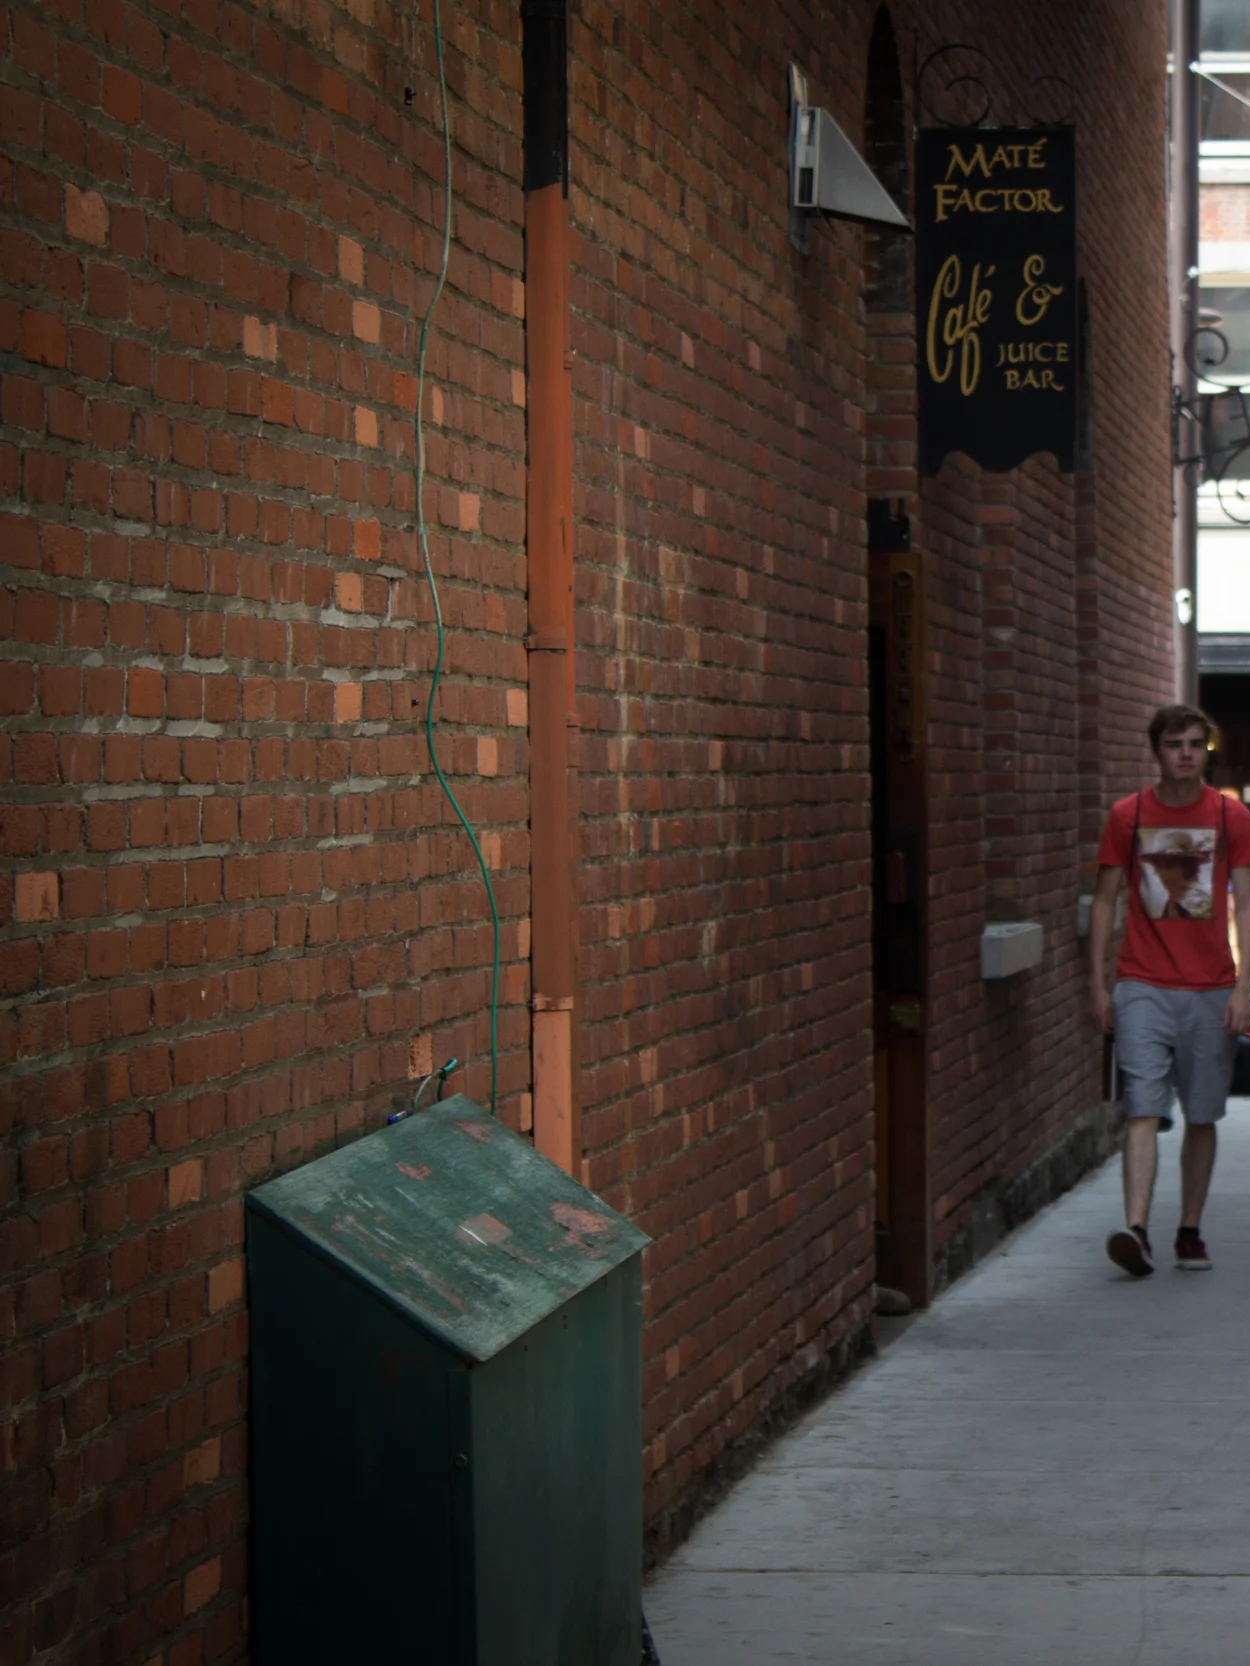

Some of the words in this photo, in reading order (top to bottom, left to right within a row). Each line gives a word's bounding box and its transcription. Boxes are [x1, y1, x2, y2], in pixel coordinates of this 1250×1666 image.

[945, 138, 1047, 181] MATÉ
[933, 184, 1064, 222] FACTOR
[926, 254, 996, 396] Café
[1015, 254, 1063, 325] &
[997, 342, 1070, 367] JUICE
[1003, 369, 1064, 391] BAR
